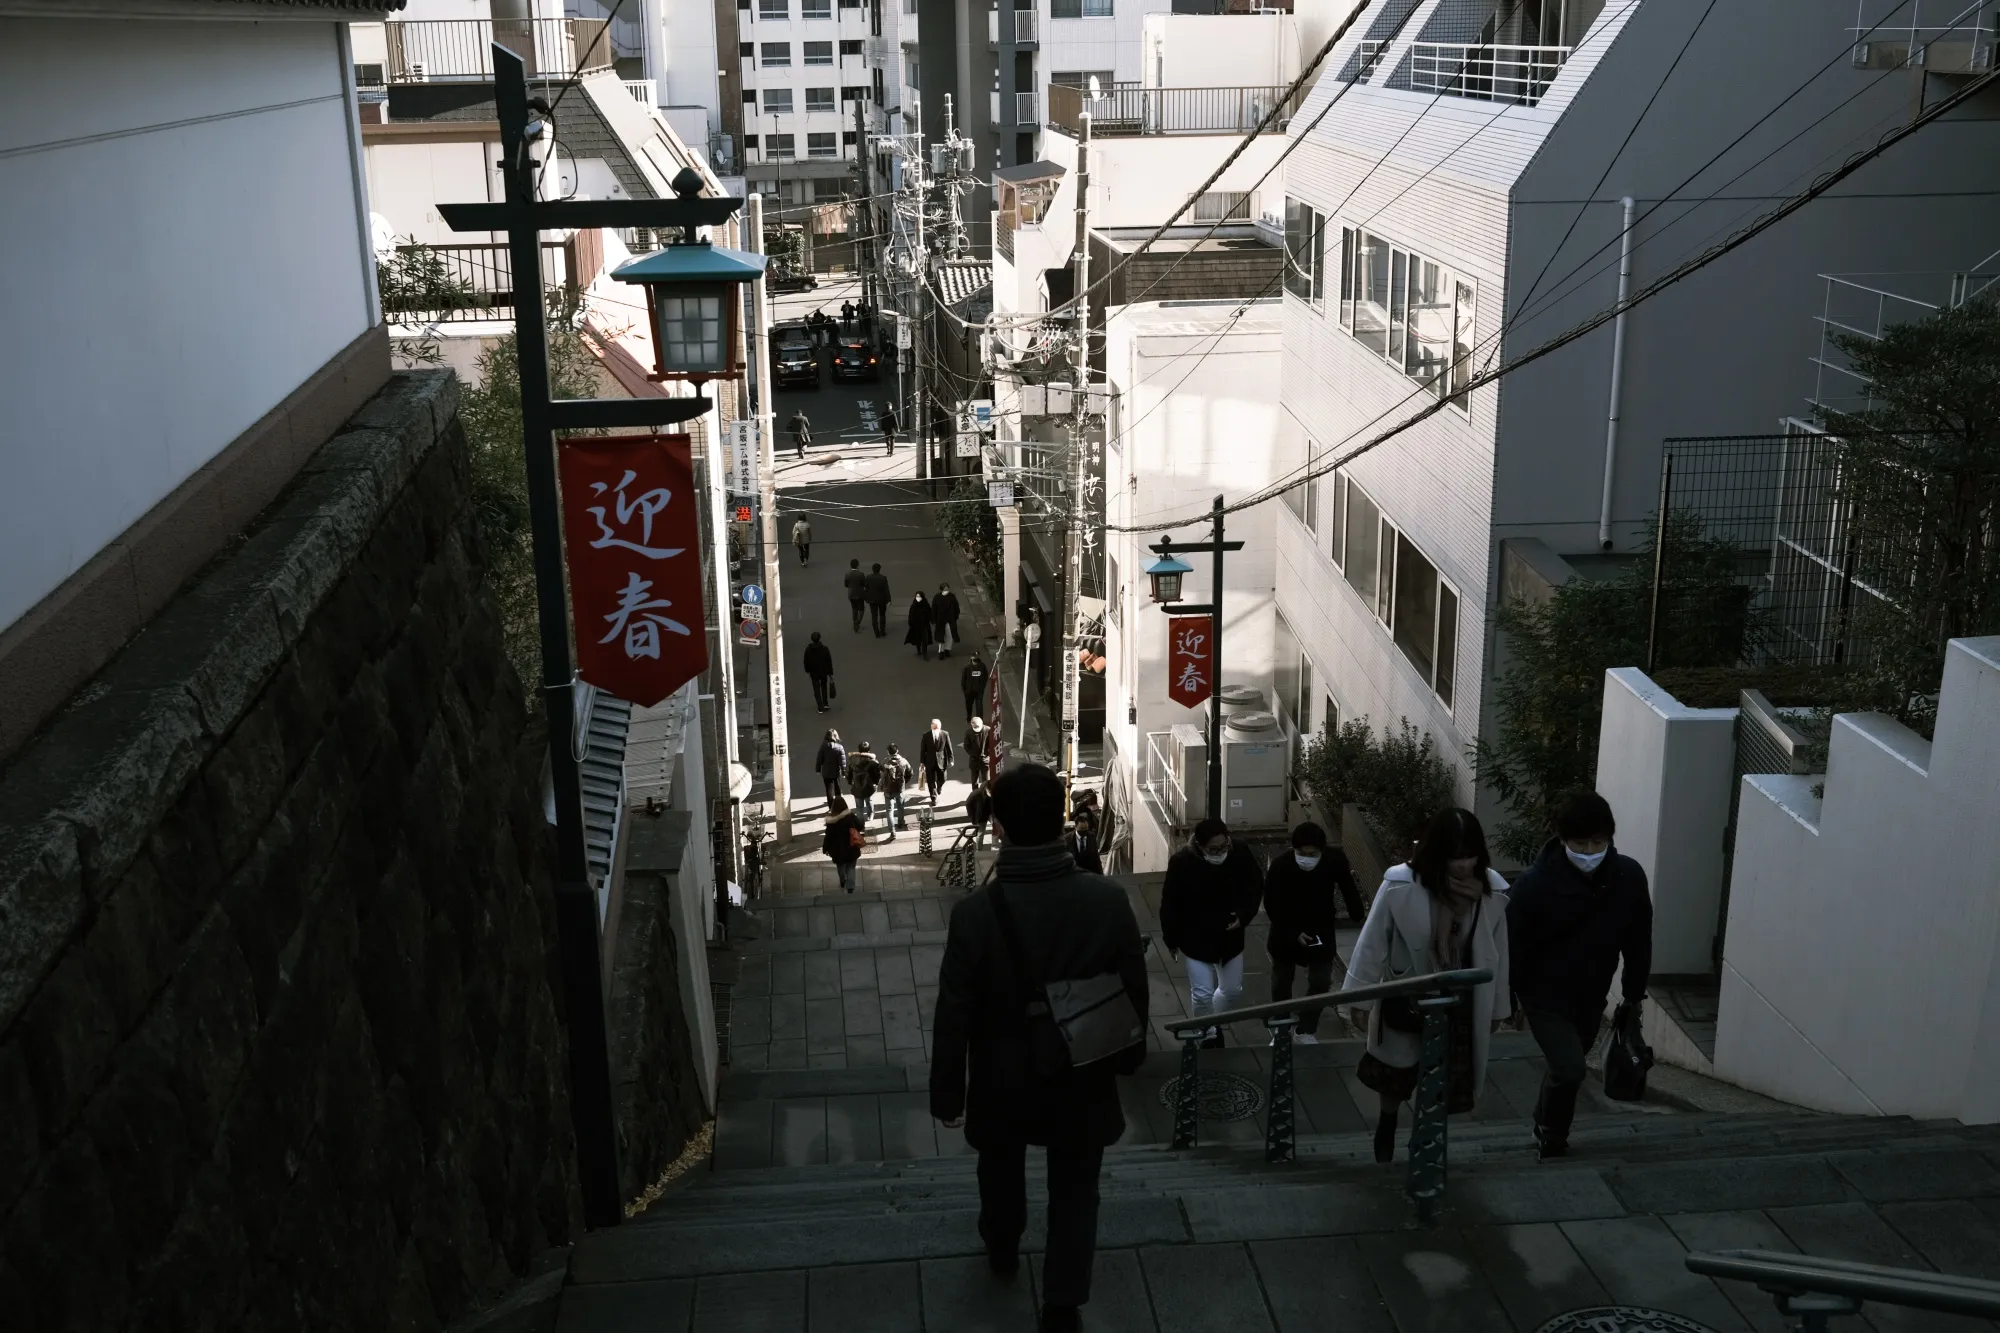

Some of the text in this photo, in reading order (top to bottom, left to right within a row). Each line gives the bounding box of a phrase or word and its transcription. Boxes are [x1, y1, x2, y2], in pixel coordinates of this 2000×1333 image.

[736, 507, 751, 521] 満
[586, 470, 690, 661] 迎春
[1176, 629, 1208, 692] 迎春
